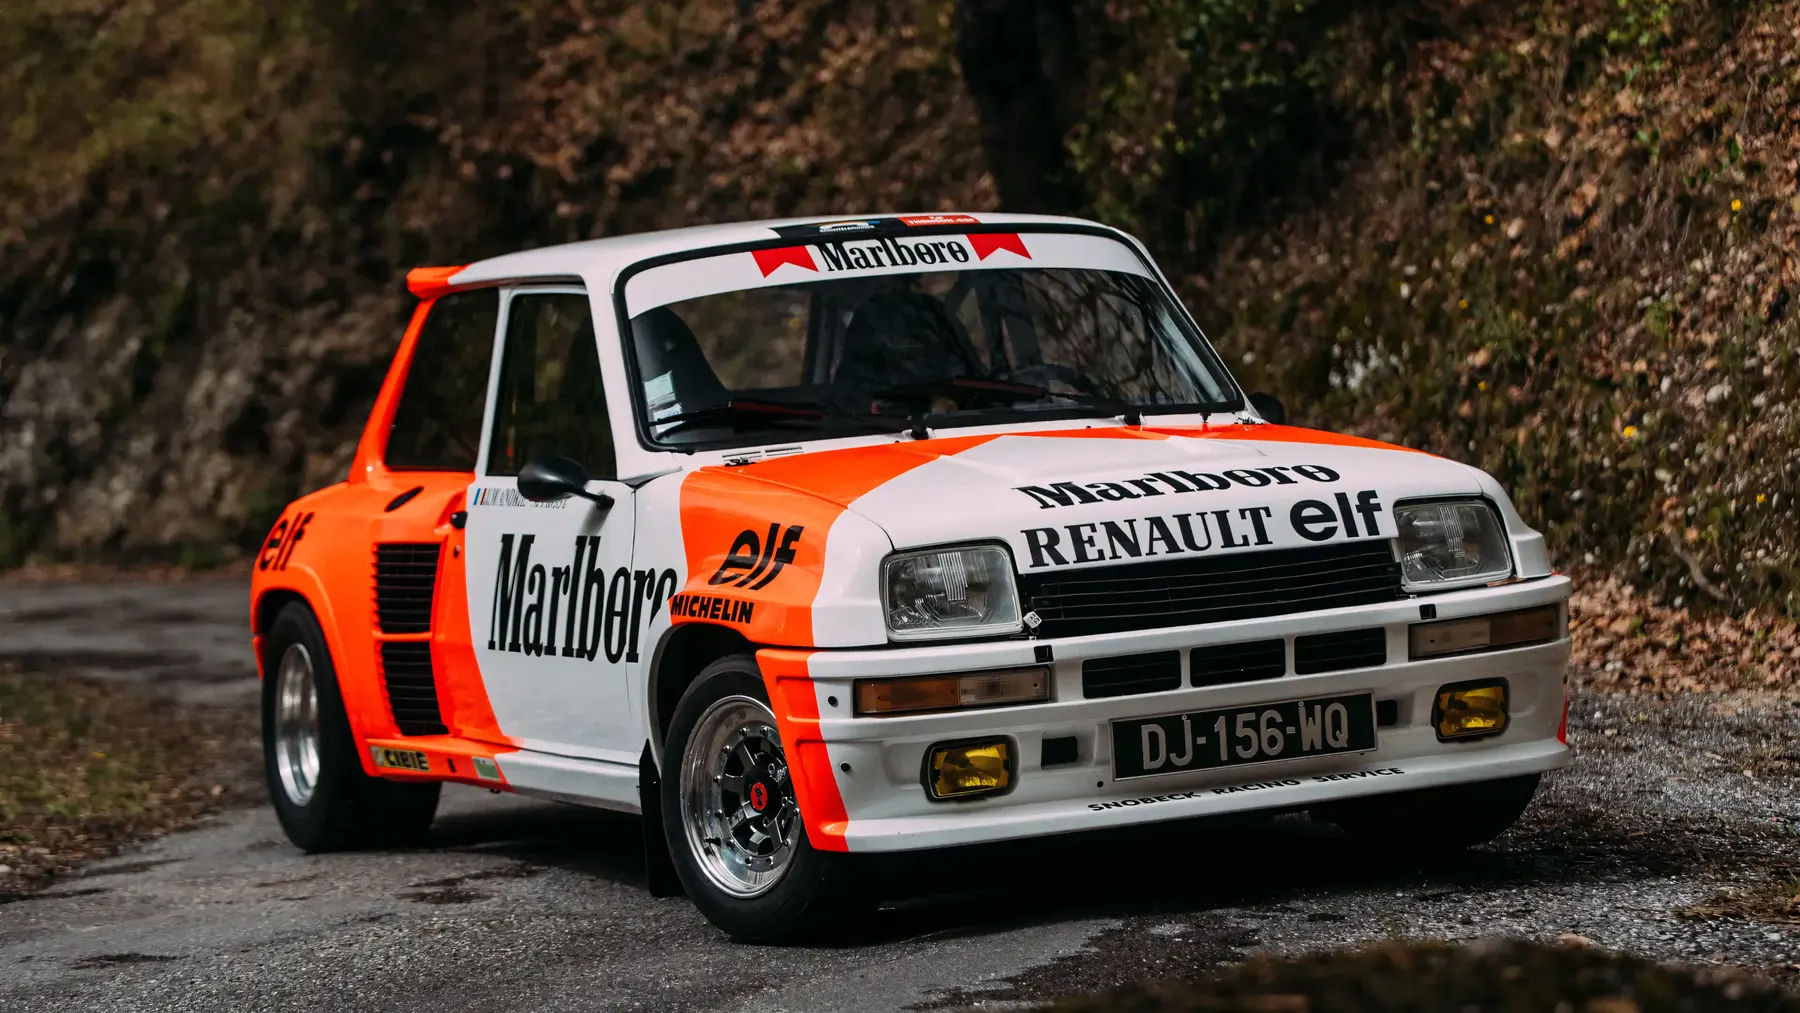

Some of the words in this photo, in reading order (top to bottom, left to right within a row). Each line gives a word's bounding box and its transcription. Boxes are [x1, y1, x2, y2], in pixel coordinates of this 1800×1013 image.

[813, 237, 969, 272] Marlboro
[1012, 464, 1340, 509] Marlboro
[260, 512, 314, 571] elf
[1020, 506, 1273, 568] RENAULT
[1290, 490, 1383, 541] elf
[708, 522, 804, 590] elf
[671, 595, 754, 624] MICHELIN
[1141, 702, 1350, 770] DJ-156-WQ
[1087, 791, 1201, 812] SNOBECK
[1211, 778, 1301, 795] RACING
[1312, 767, 1406, 783] SERVICE
